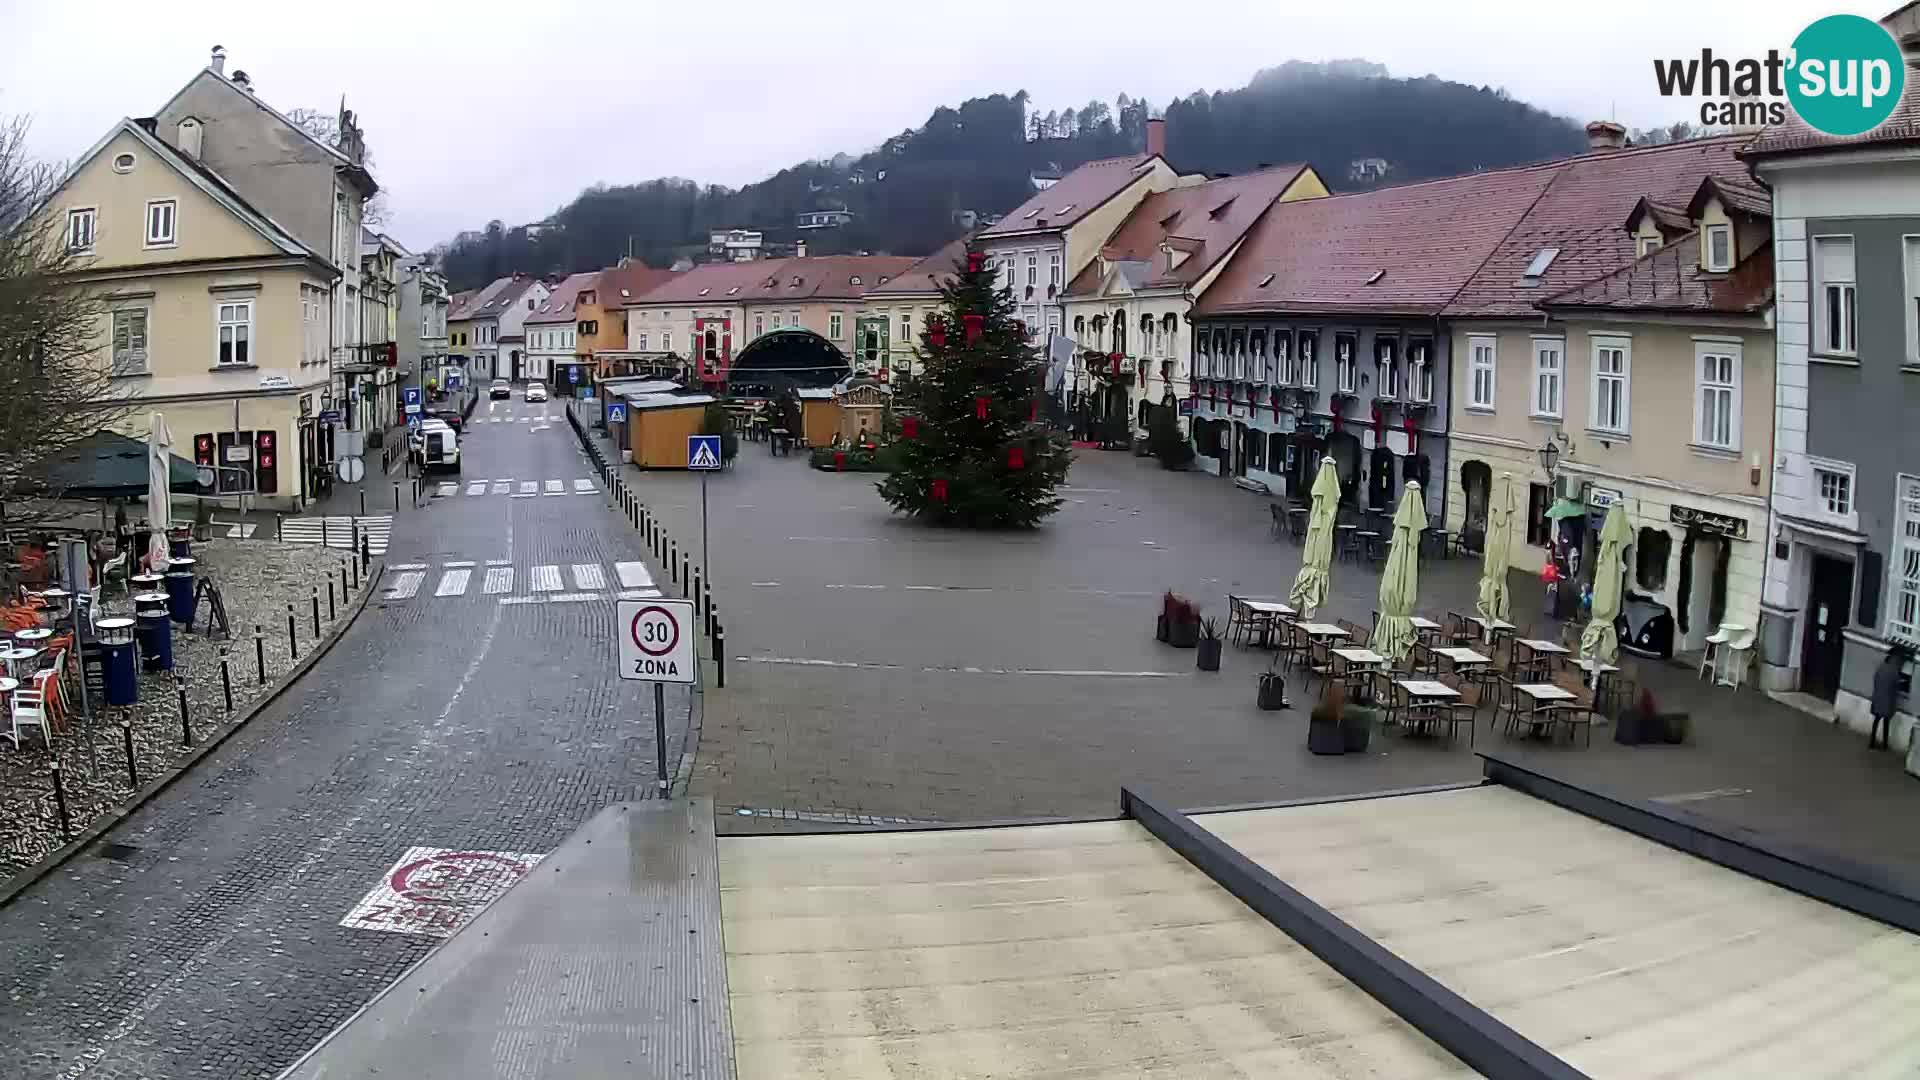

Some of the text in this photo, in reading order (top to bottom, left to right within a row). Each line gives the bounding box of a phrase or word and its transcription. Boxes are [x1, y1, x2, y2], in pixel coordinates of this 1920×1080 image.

[409, 391, 416, 402] P
[644, 621, 668, 643] 30
[634, 659, 679, 676] ZONA
